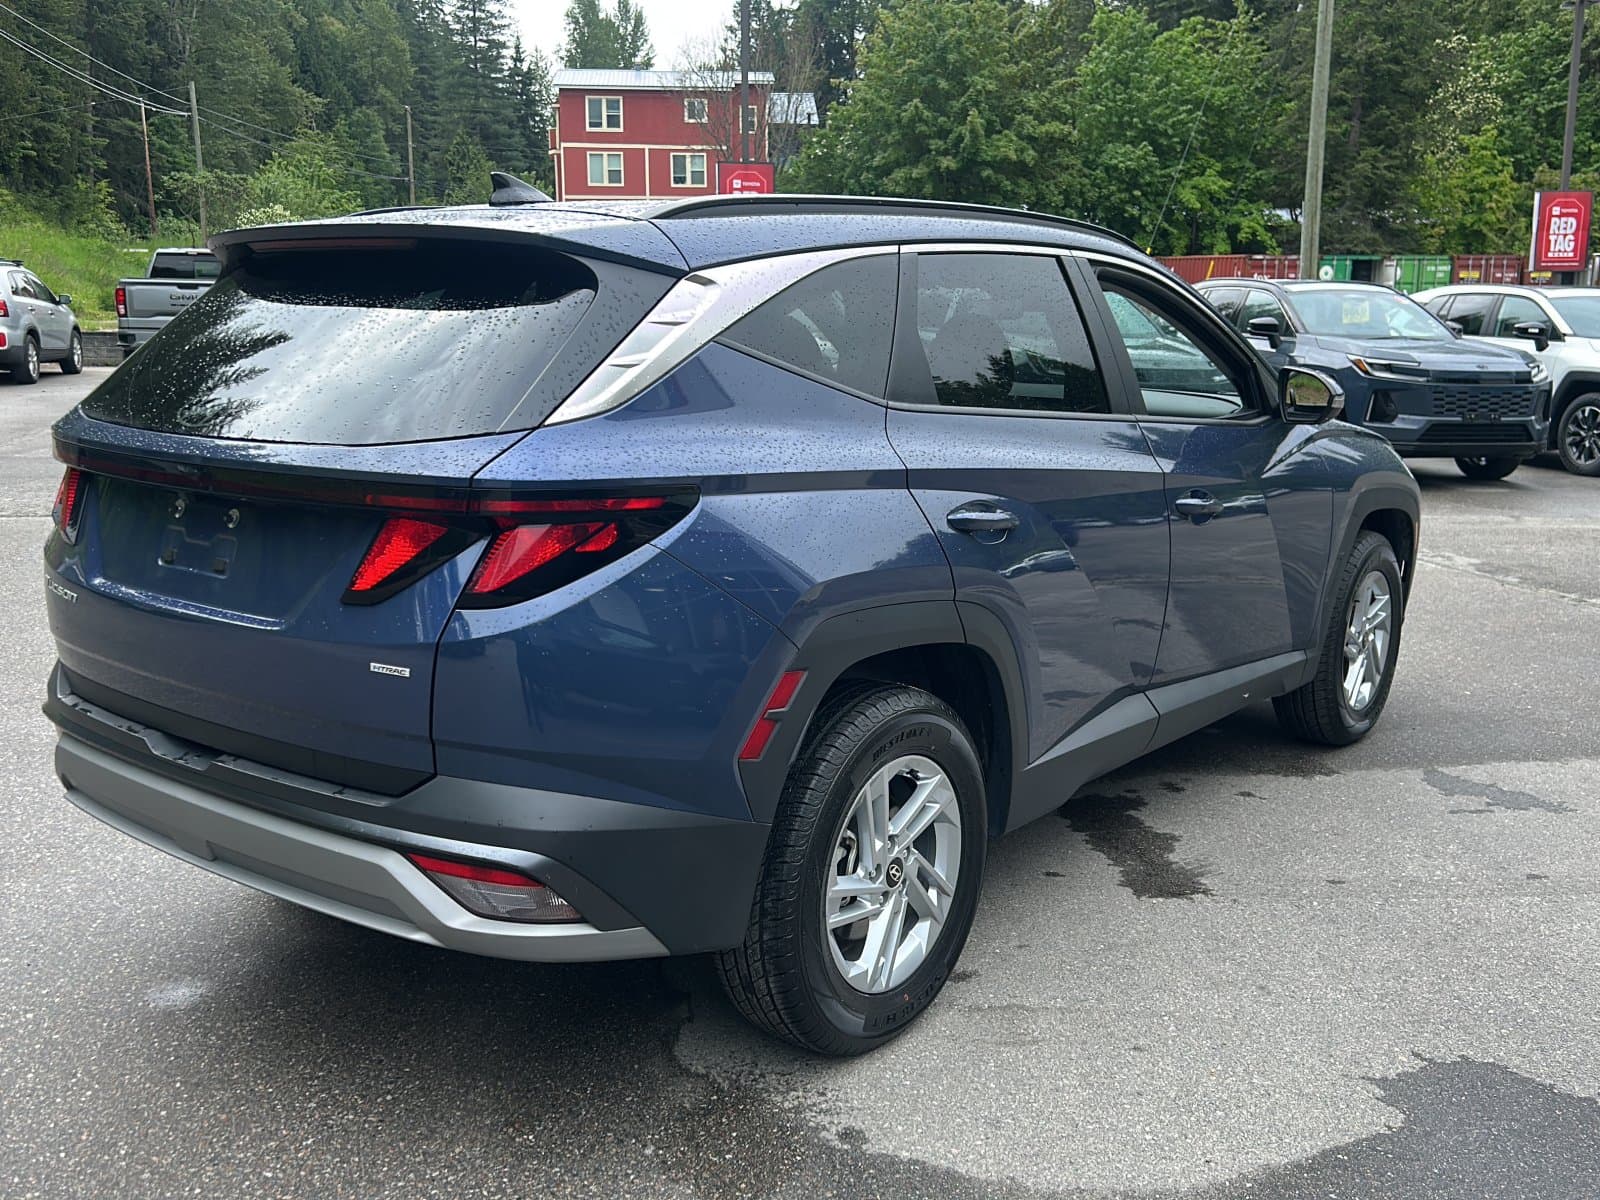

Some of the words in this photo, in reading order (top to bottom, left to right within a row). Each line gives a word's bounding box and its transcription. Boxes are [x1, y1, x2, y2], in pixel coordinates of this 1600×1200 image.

[1549, 216, 1577, 235] RED
[1548, 234, 1576, 252] TAG
[371, 663, 410, 677] HTRAC
